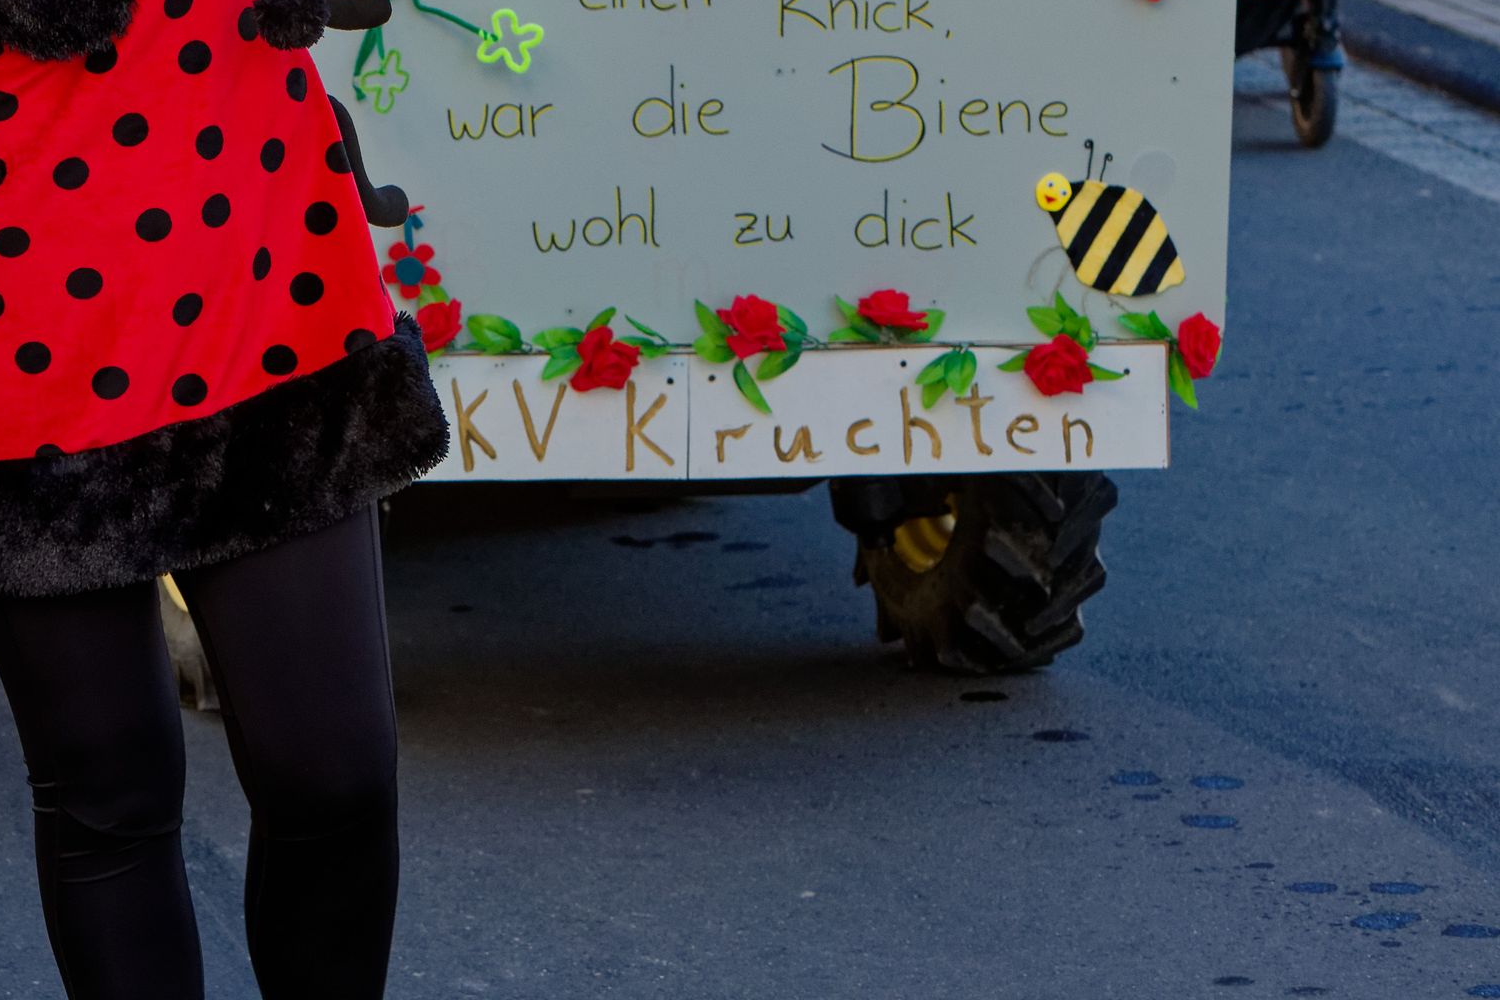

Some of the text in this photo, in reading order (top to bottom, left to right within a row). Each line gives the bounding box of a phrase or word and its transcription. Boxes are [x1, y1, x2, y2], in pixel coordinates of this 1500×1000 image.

[447, 55, 1069, 163] war die Biene
[532, 186, 977, 252] wohl zu dick
[626, 379, 1094, 473] Kruchten
